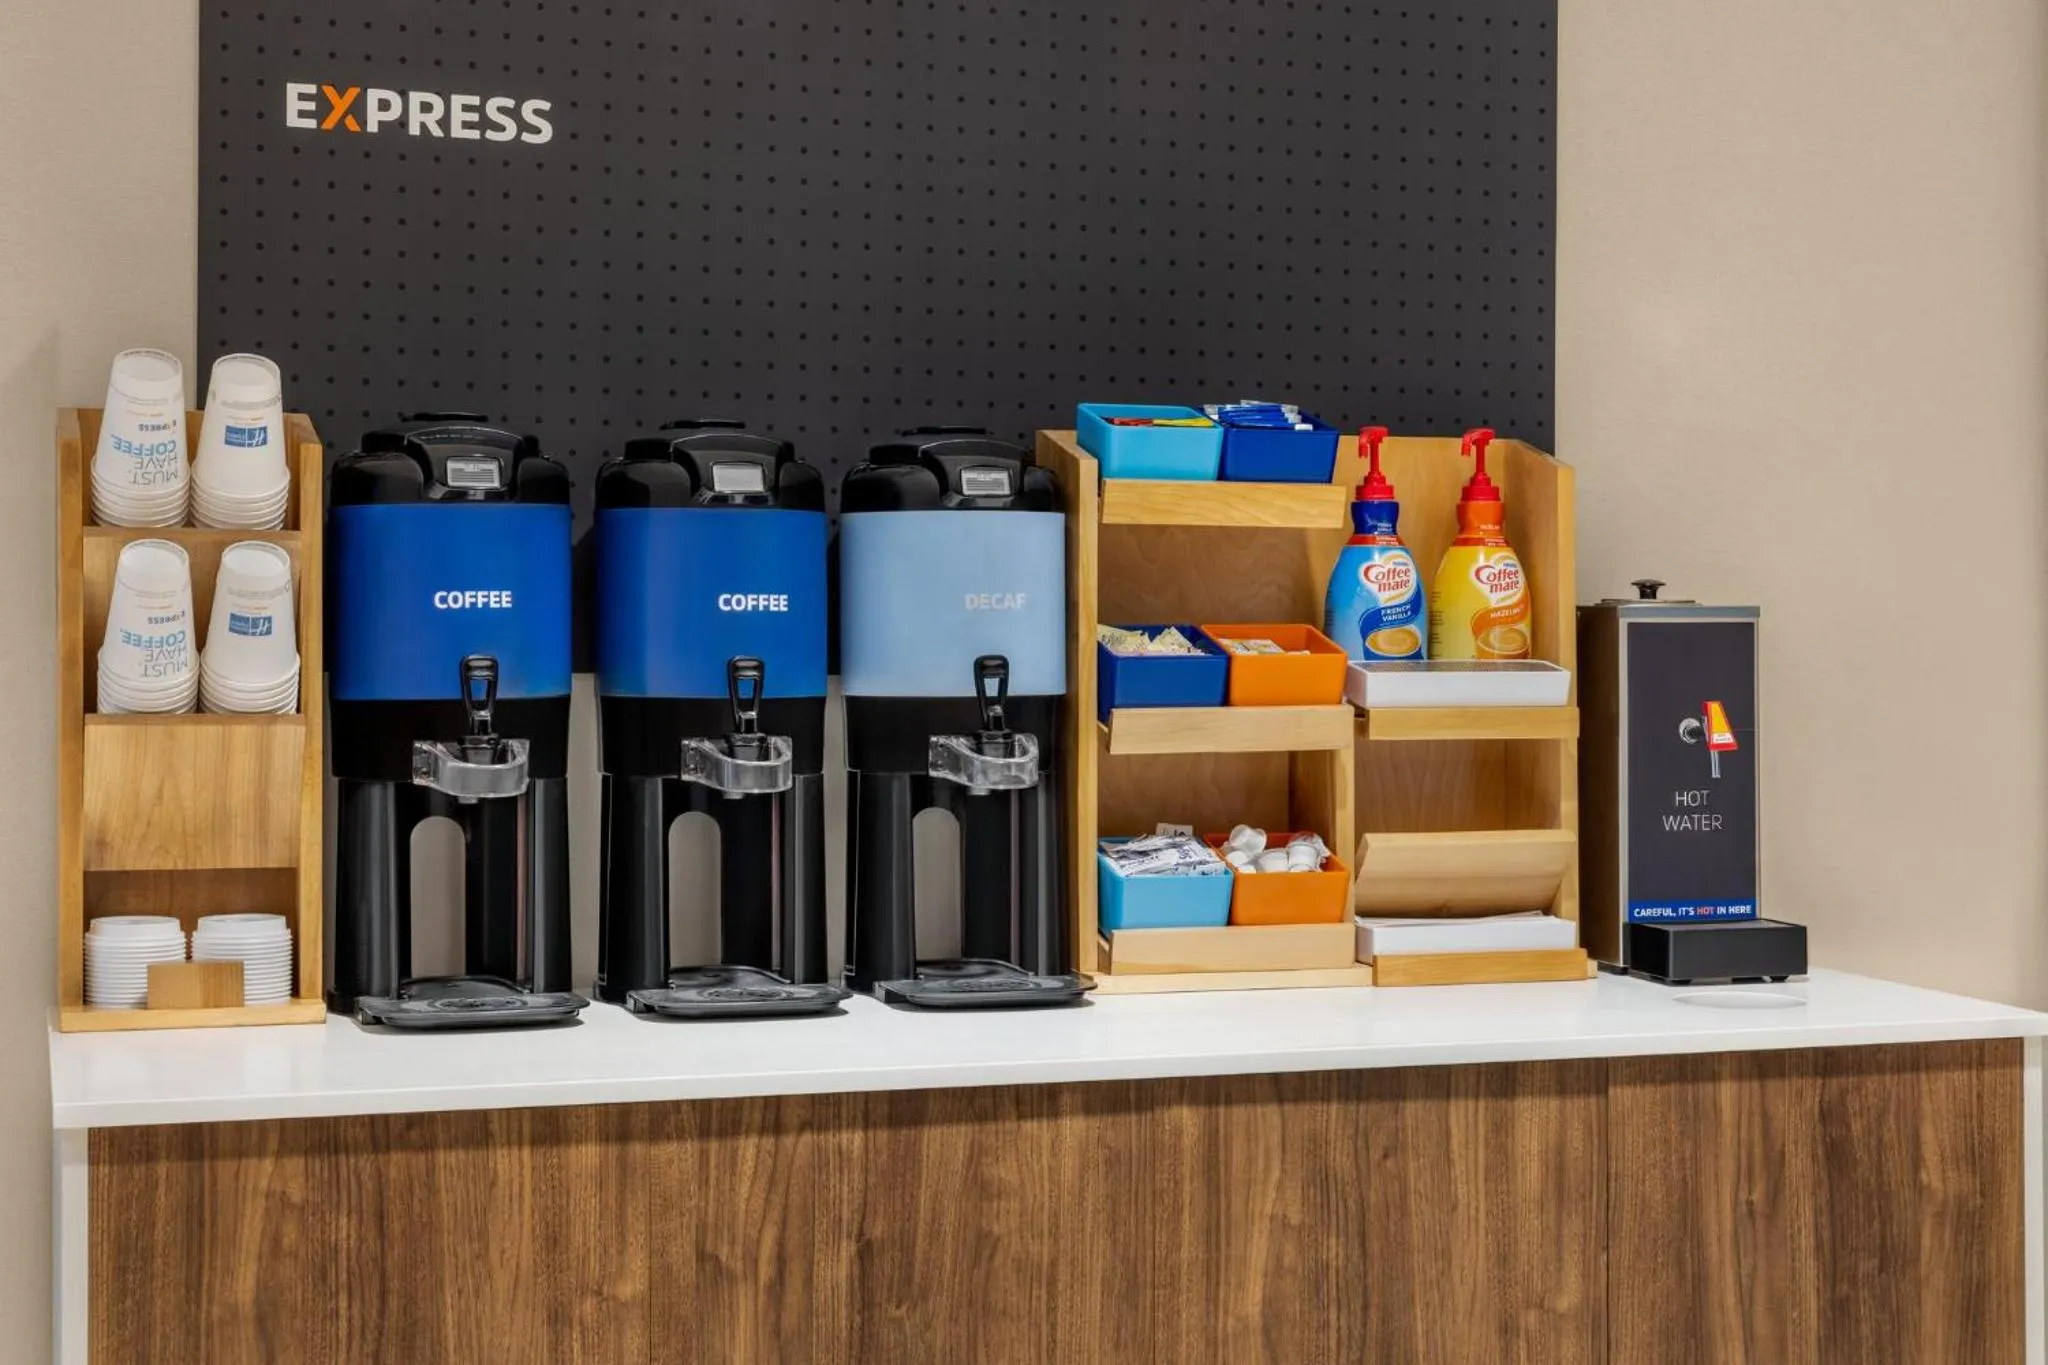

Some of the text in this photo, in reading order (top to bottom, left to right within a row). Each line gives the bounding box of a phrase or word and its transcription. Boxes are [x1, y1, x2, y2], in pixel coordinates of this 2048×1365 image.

[286, 82, 553, 144] EXPRESS
[1363, 563, 1411, 584] Coffee
[1474, 564, 1519, 584] Coffee
[1378, 579, 1410, 593] mate
[1489, 579, 1520, 594] mate
[433, 590, 513, 609] COFFEE
[718, 593, 789, 612] COFFEE
[965, 592, 1027, 610] DECAF
[1675, 790, 1711, 807] HOT
[1662, 814, 1723, 831] WATER
[1678, 907, 1695, 916] IT'S
[1696, 906, 1715, 915] HOT
[1717, 906, 1727, 915] IN
[1728, 904, 1752, 914] HERE
